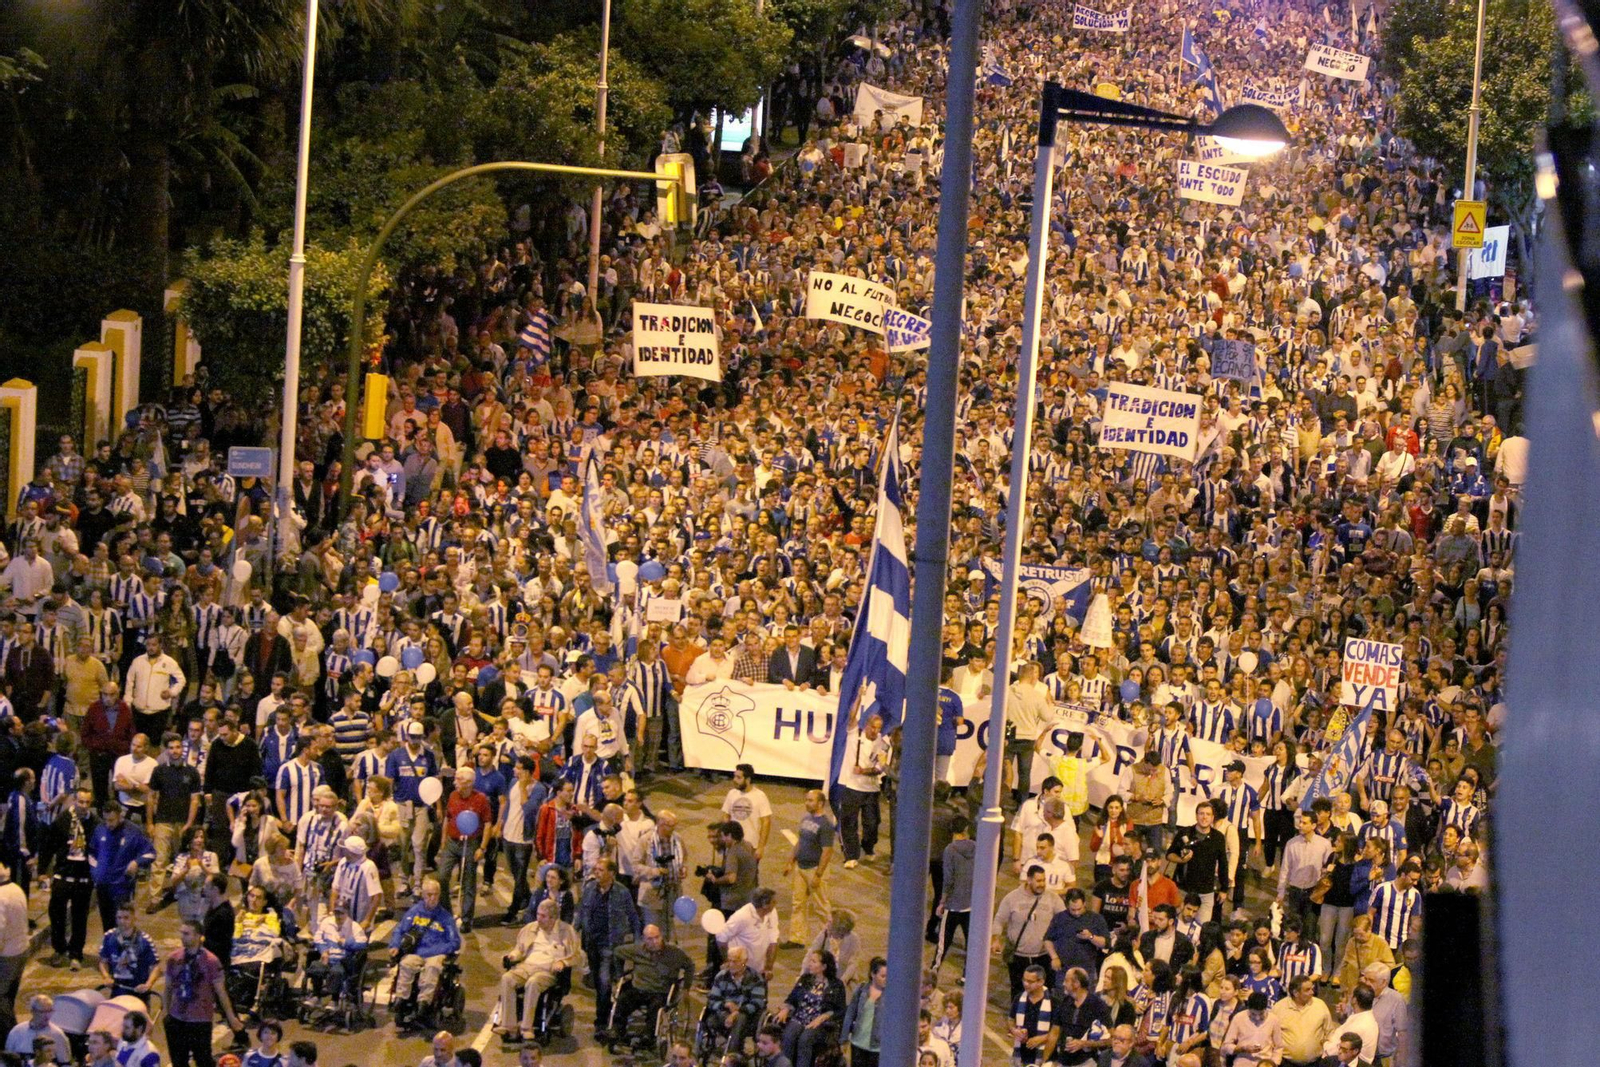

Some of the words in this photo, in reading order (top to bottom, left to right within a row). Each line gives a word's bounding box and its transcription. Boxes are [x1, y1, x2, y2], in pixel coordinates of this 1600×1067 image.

[1312, 44, 1322, 52] NO
[1323, 47, 1332, 56] AL
[1202, 147, 1223, 160] ANTE
[1180, 163, 1190, 175] EL
[1197, 164, 1241, 184] ESCUDO
[1179, 177, 1204, 192] ANTE
[1211, 182, 1235, 197] TODO
[813, 278, 833, 291] NO
[840, 282, 857, 295] AL
[639, 314, 714, 334] TRADICION
[830, 302, 884, 328] NEGOCI
[678, 334, 685, 346] E
[638, 346, 714, 365] IDENTIDAD
[1109, 392, 1196, 419] TRADICION
[1146, 417, 1154, 429] E
[1103, 425, 1188, 448] IDENTIDAD
[1346, 640, 1402, 666] COMAS
[1344, 662, 1397, 689] VENDE
